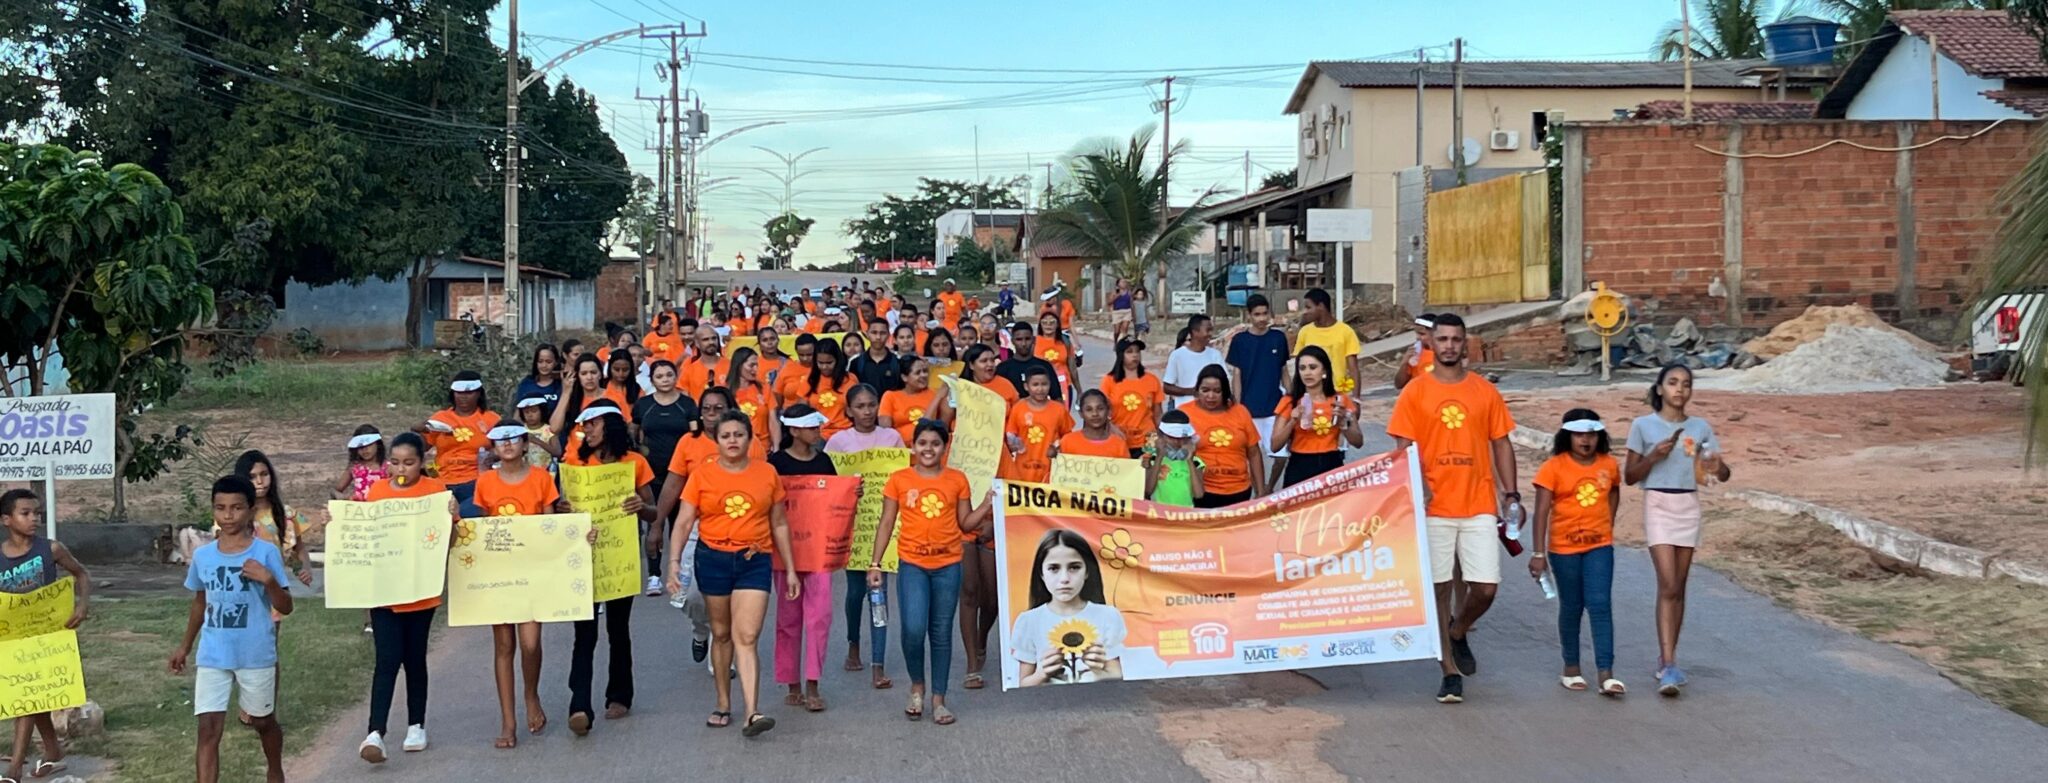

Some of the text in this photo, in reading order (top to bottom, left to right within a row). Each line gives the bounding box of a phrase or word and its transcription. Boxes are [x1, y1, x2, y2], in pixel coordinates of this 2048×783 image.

[1, 397, 81, 416] Pousada
[0, 442, 19, 456] DO
[1008, 483, 1062, 508] DIGA
[1070, 490, 1127, 517] NÃO!
[1270, 479, 1323, 502] CONTRA
[1325, 457, 1393, 487] CRIANÇAS
[1296, 503, 1388, 554] Maio
[1149, 552, 1181, 562] ABUSO
[1183, 550, 1204, 560] NÃO
[1274, 540, 1394, 583] laranja
[1165, 592, 1236, 607] DENUNCIE
[1193, 634, 1227, 655] 100
[1339, 646, 1377, 656] SOCIAL
[10, 691, 70, 715] BONITO
